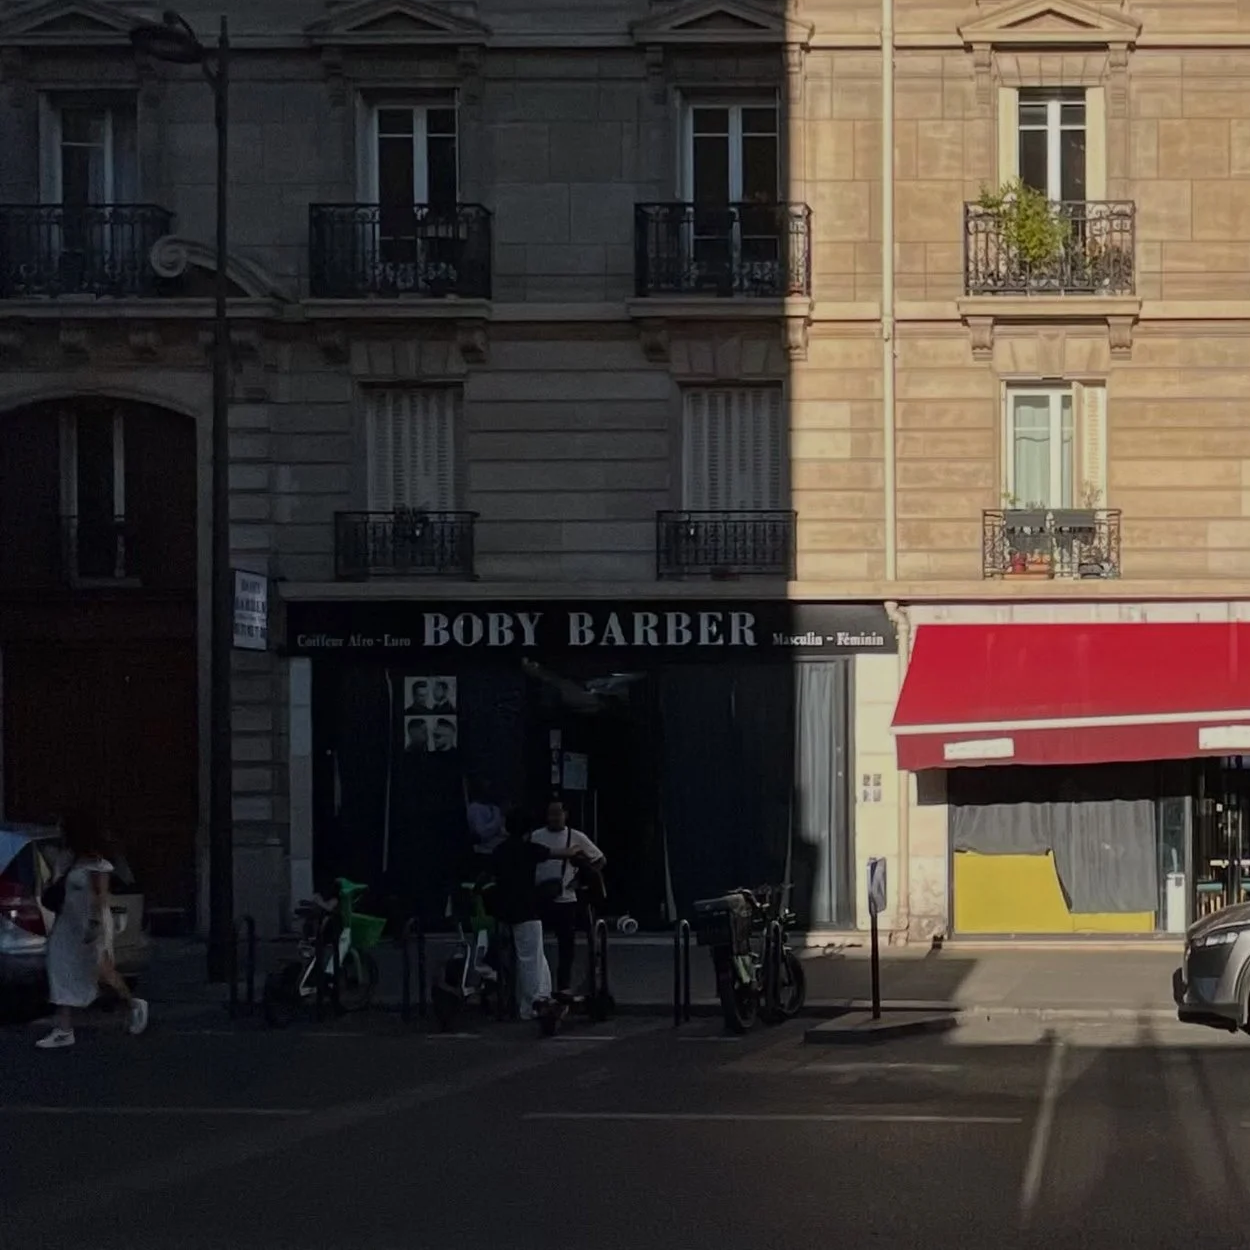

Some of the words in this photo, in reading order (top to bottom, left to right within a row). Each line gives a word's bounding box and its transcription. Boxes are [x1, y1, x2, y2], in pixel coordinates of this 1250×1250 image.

[422, 611, 544, 647] BOBY
[567, 611, 758, 647] BARBER
[772, 632, 823, 646] Masculin
[837, 632, 884, 646] Féminin
